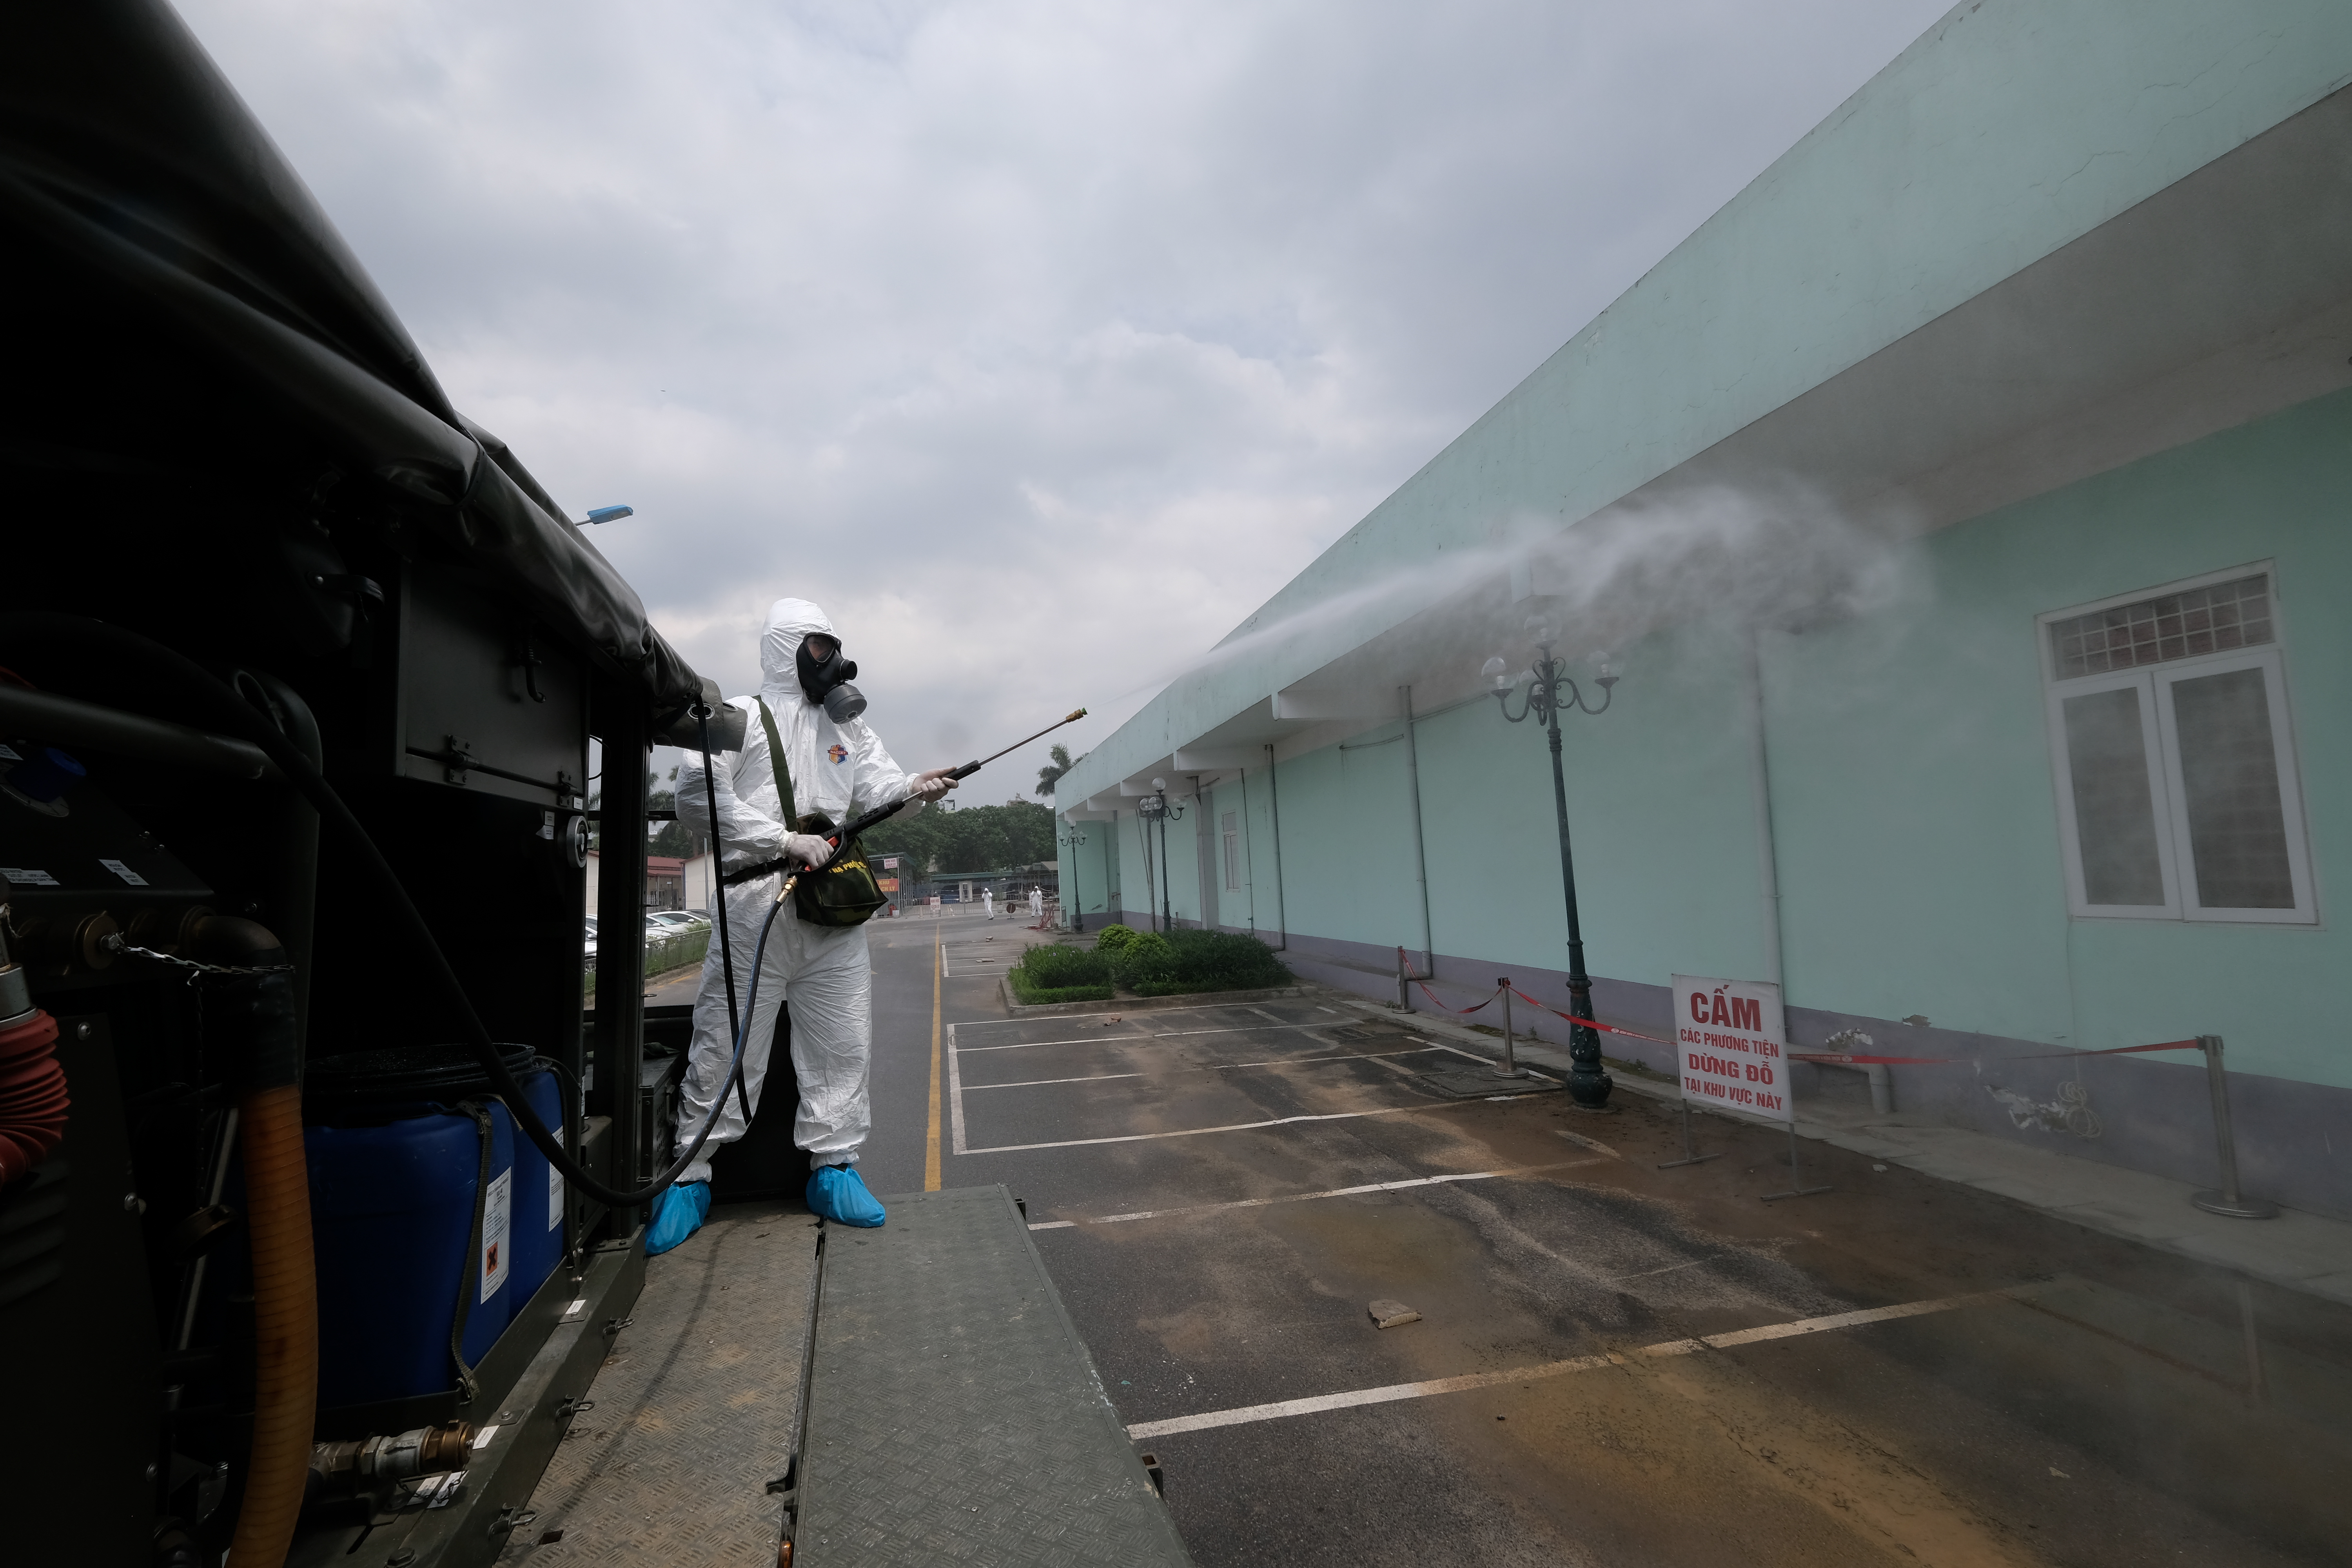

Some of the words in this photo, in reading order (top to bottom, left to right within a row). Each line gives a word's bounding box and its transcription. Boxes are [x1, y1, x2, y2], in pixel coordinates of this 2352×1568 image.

[1690, 985, 1761, 1032] CẤM
[1680, 1027, 1700, 1044] CÁC
[1704, 1033, 1749, 1052] PHƯƠNG
[1752, 1039, 1779, 1058] TIỆN
[1688, 1053, 1739, 1079] DỪNG
[1746, 1061, 1773, 1085] ĐỖ
[1684, 1077, 1700, 1094] TẠI
[1704, 1081, 1726, 1098] KHU
[1729, 1086, 1752, 1105] VỰC
[1756, 1092, 1782, 1110] NÀY
